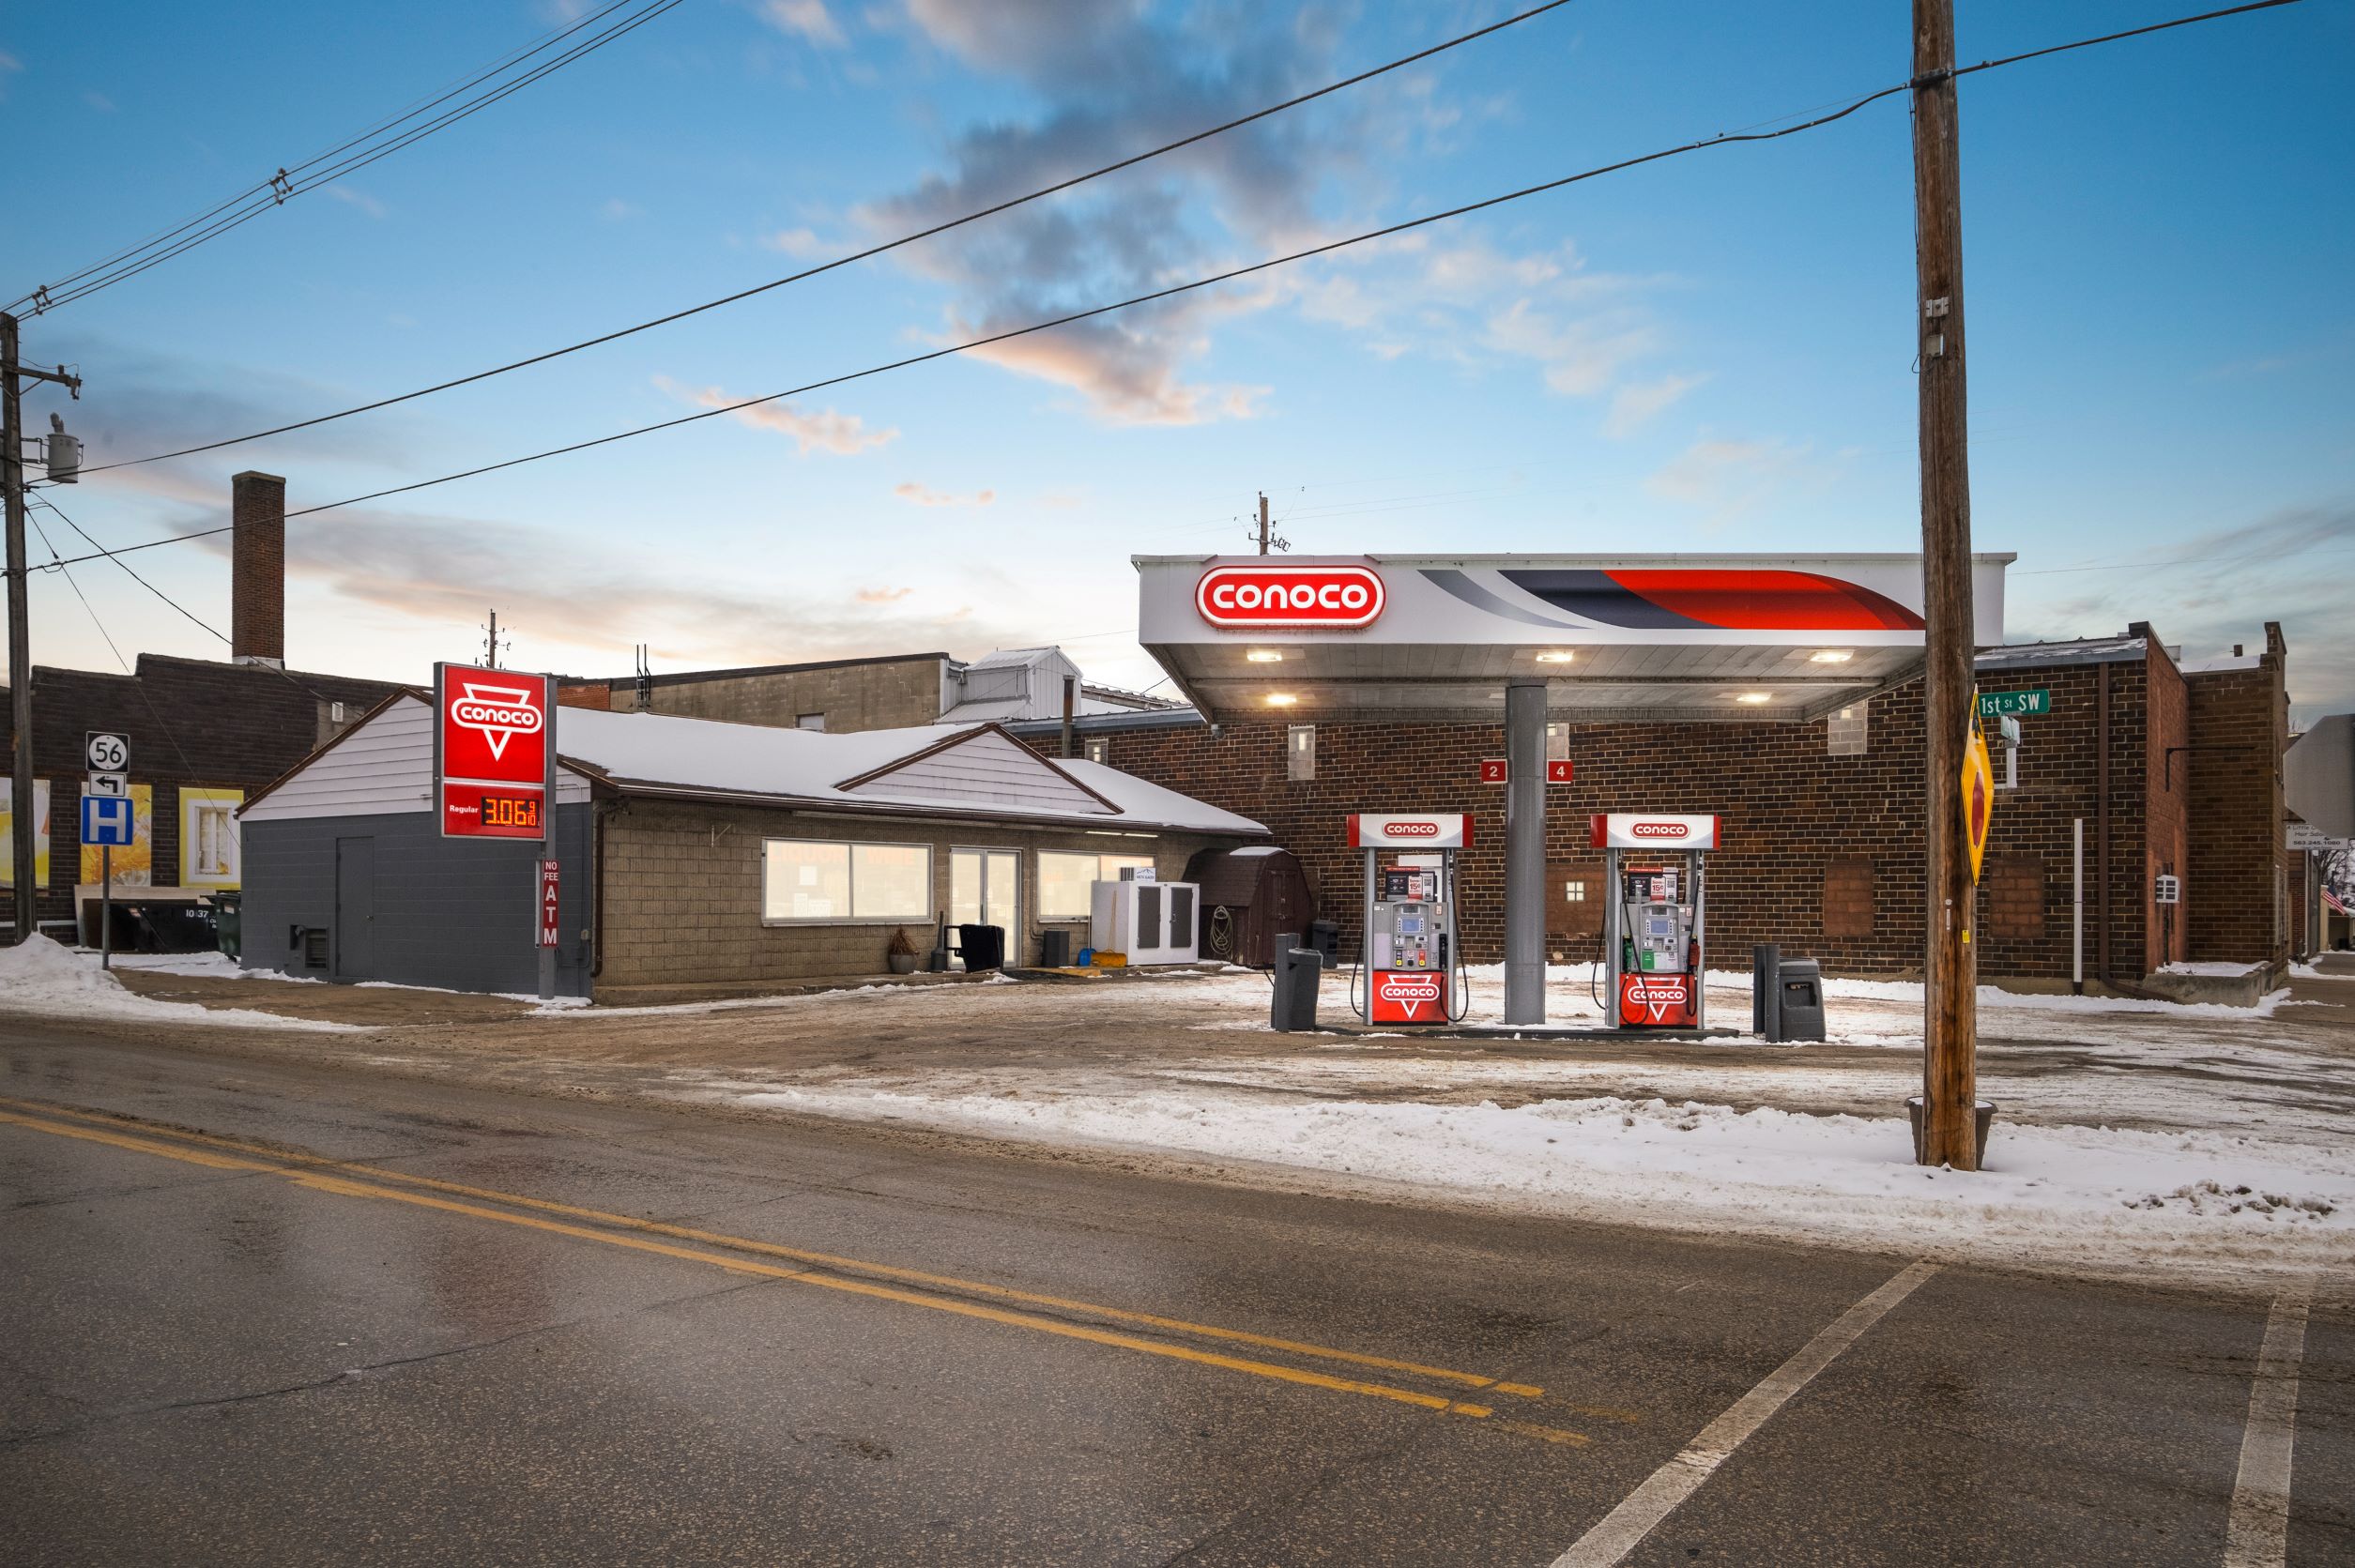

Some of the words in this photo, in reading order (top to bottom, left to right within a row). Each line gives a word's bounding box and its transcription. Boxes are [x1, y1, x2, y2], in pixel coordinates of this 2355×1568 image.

[1980, 696, 2000, 714] 1st
[2004, 699, 2012, 708] St
[2018, 693, 2040, 711] SW
[95, 741, 122, 764] 56
[1489, 766, 1498, 777] 2
[1556, 766, 1565, 777] 4
[449, 804, 479, 814] Regular
[528, 800, 536, 813] 9
[88, 799, 127, 843] H
[768, 846, 845, 863] LIQUOR
[545, 861, 558, 871] NO
[543, 872, 558, 881] FEE
[543, 885, 558, 944] ATM
